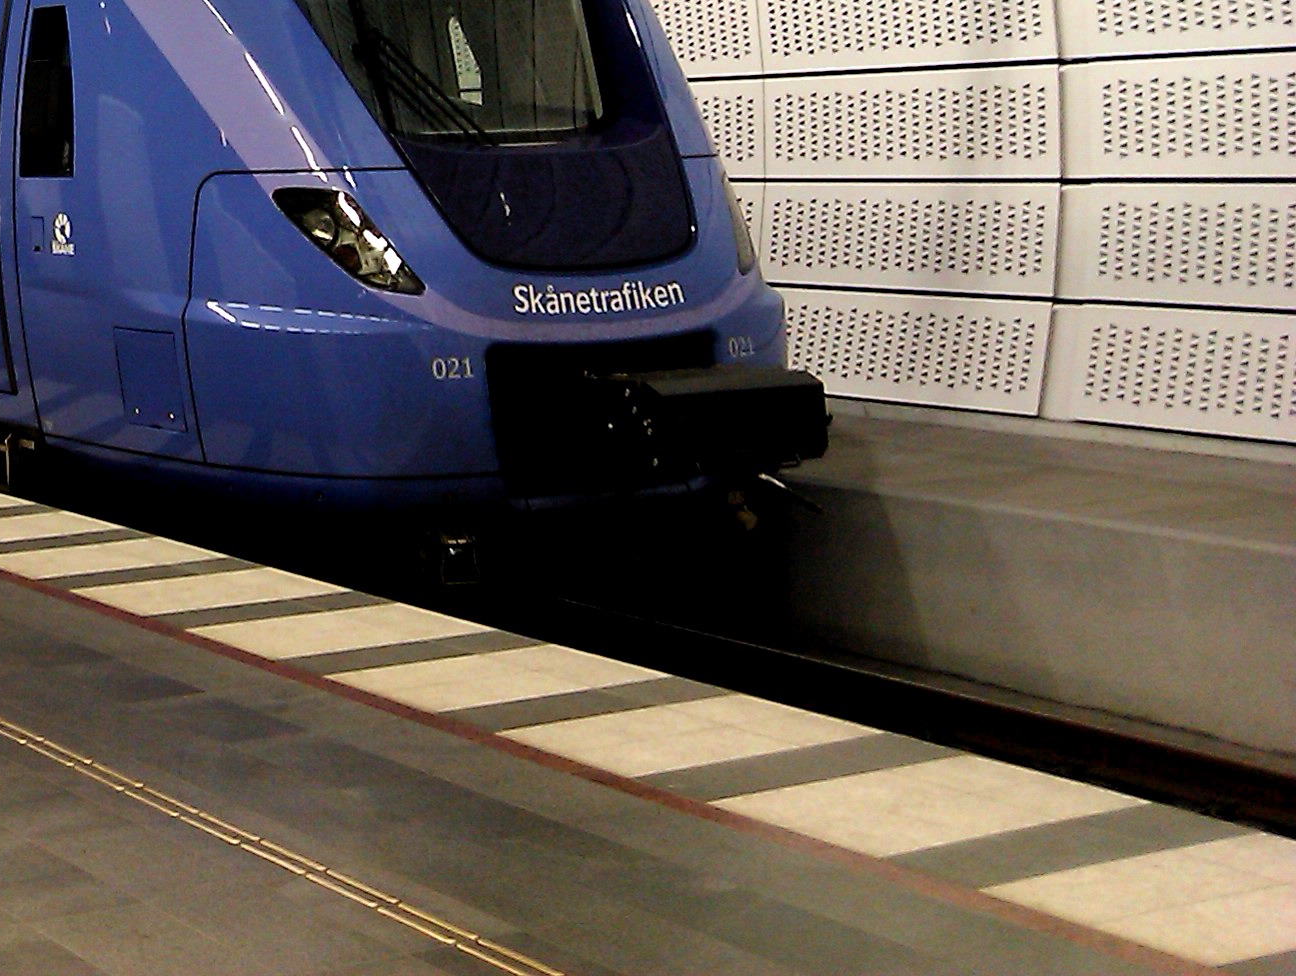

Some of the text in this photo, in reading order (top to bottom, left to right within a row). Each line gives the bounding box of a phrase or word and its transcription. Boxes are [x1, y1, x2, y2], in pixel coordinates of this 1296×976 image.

[513, 280, 685, 315] Skånetrafiken
[728, 336, 756, 358] 021
[431, 357, 475, 380] 021
